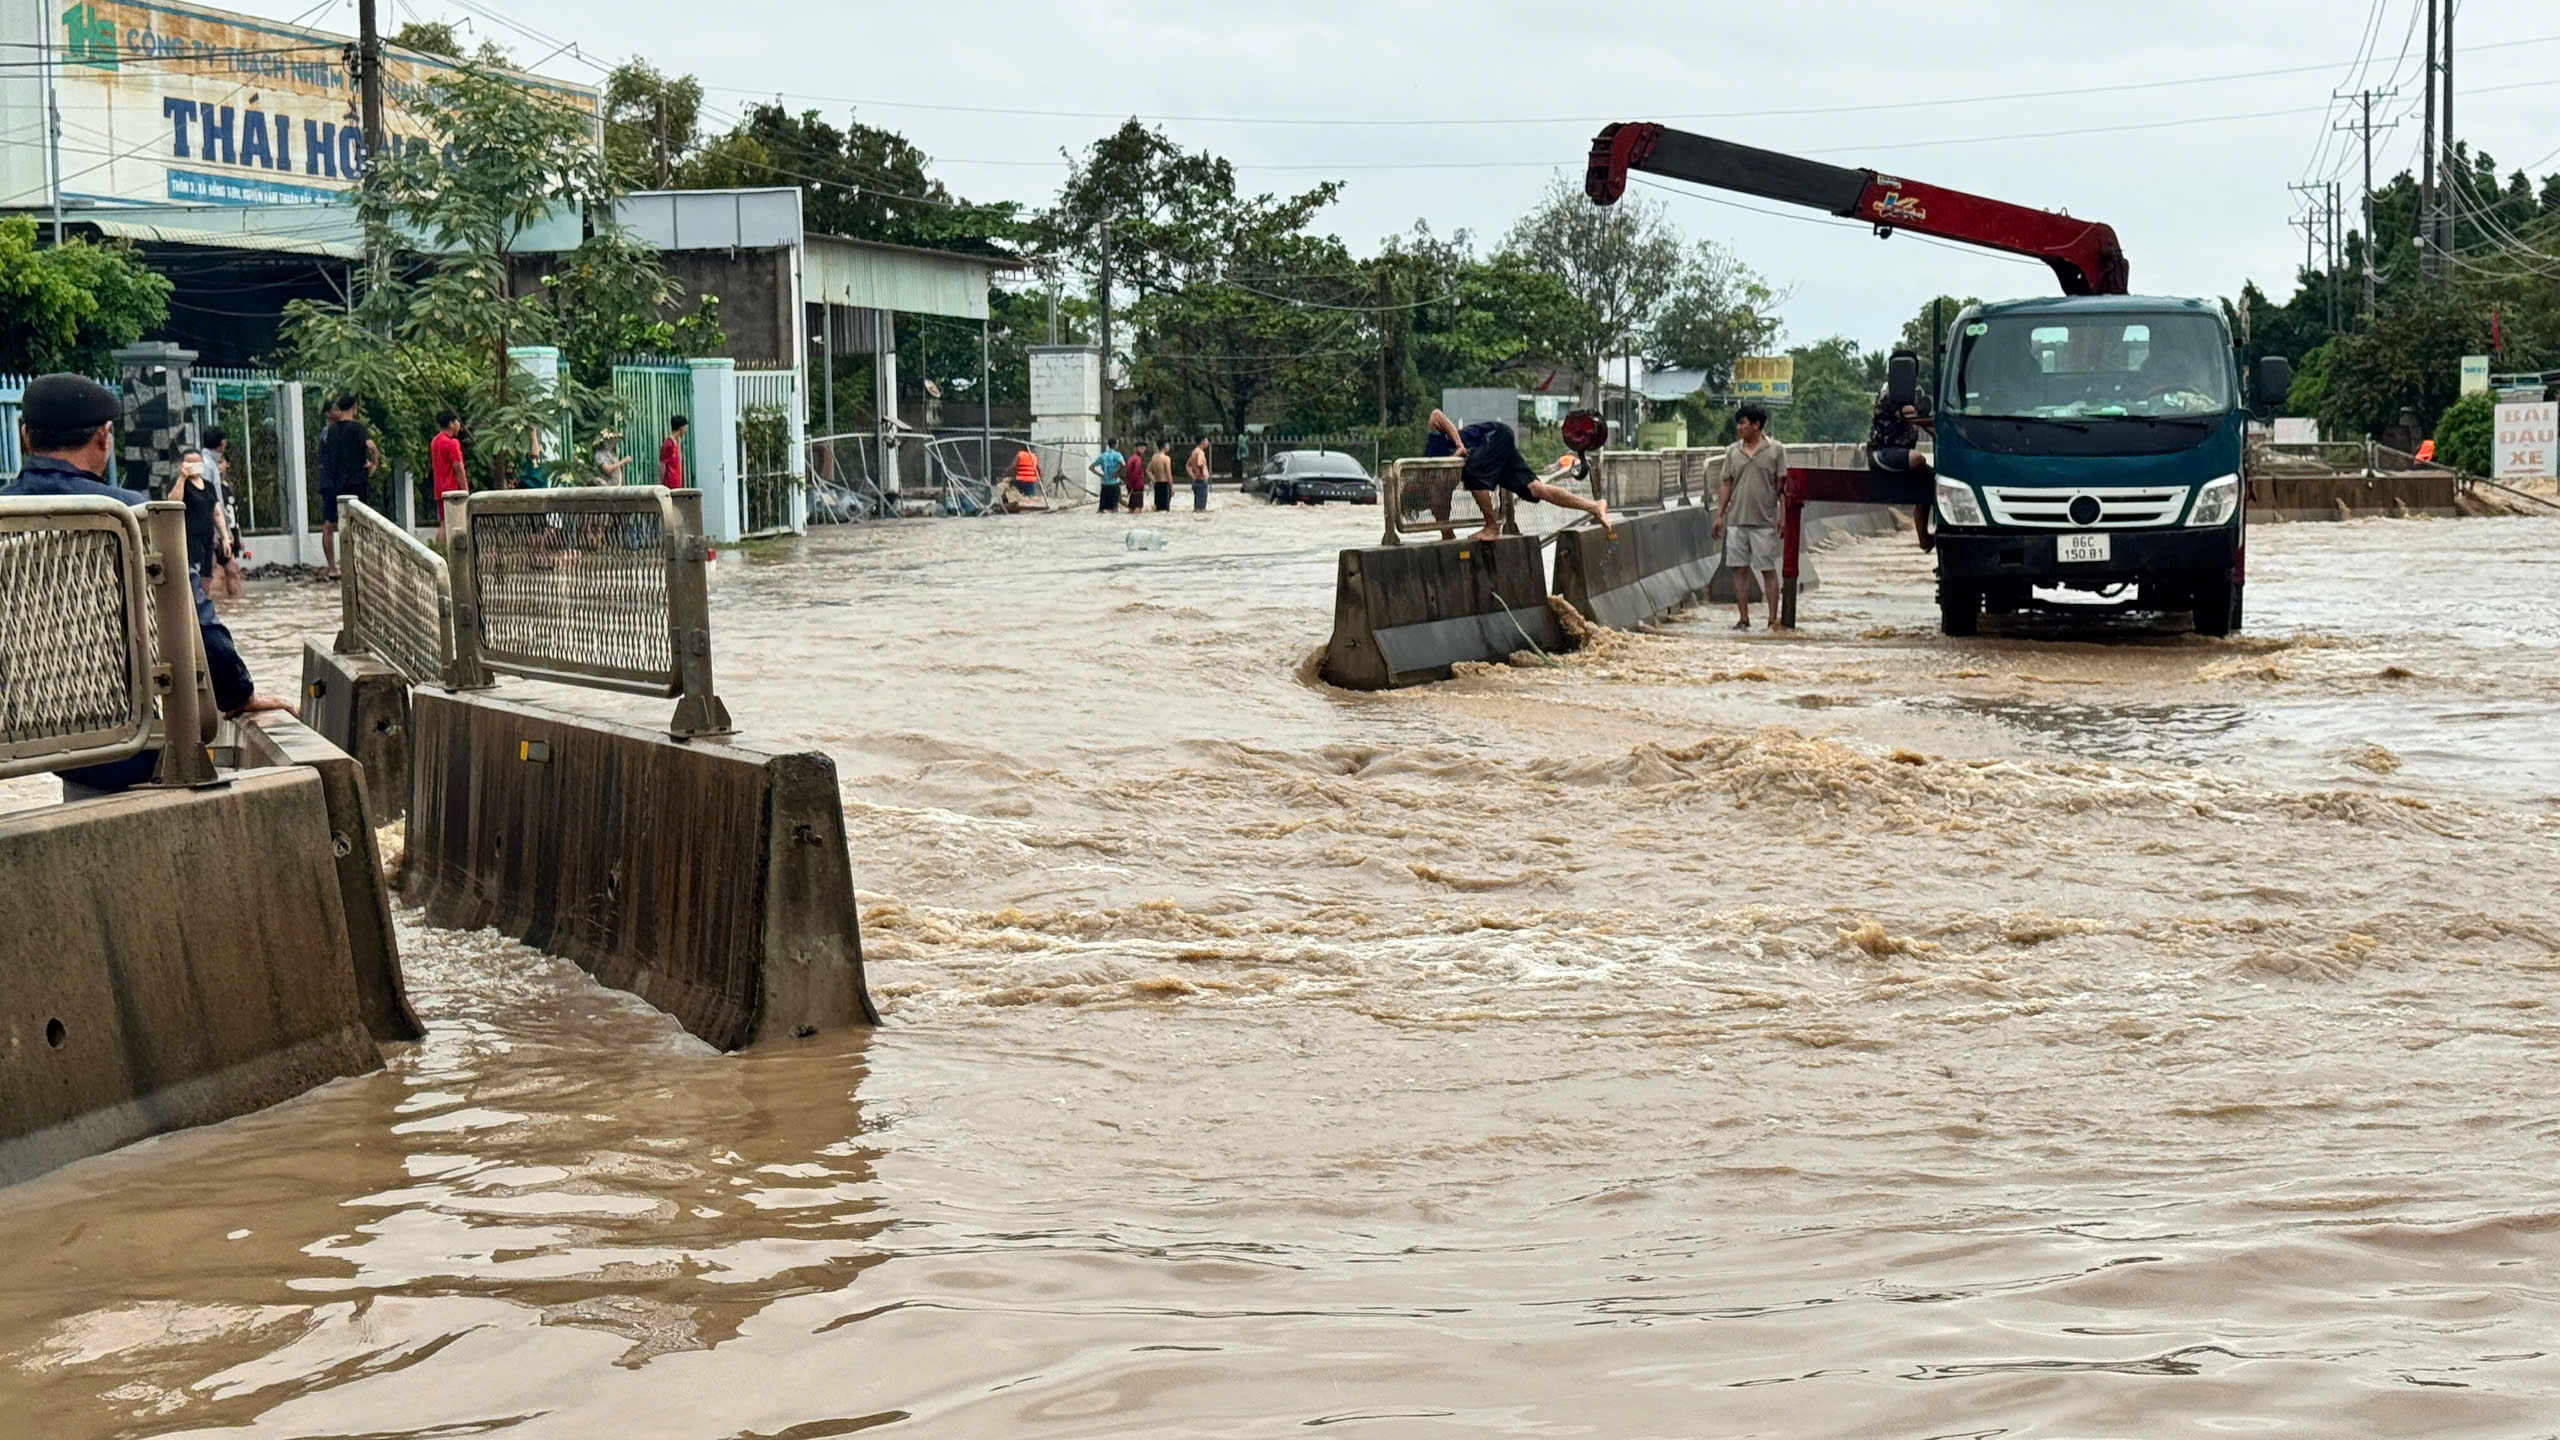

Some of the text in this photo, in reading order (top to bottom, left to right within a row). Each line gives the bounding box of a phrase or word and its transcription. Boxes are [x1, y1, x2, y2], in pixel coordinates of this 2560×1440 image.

[163, 92, 292, 173] THÁI
[2509, 450, 2545, 465] XE
[2072, 536, 2095, 548] 86C
